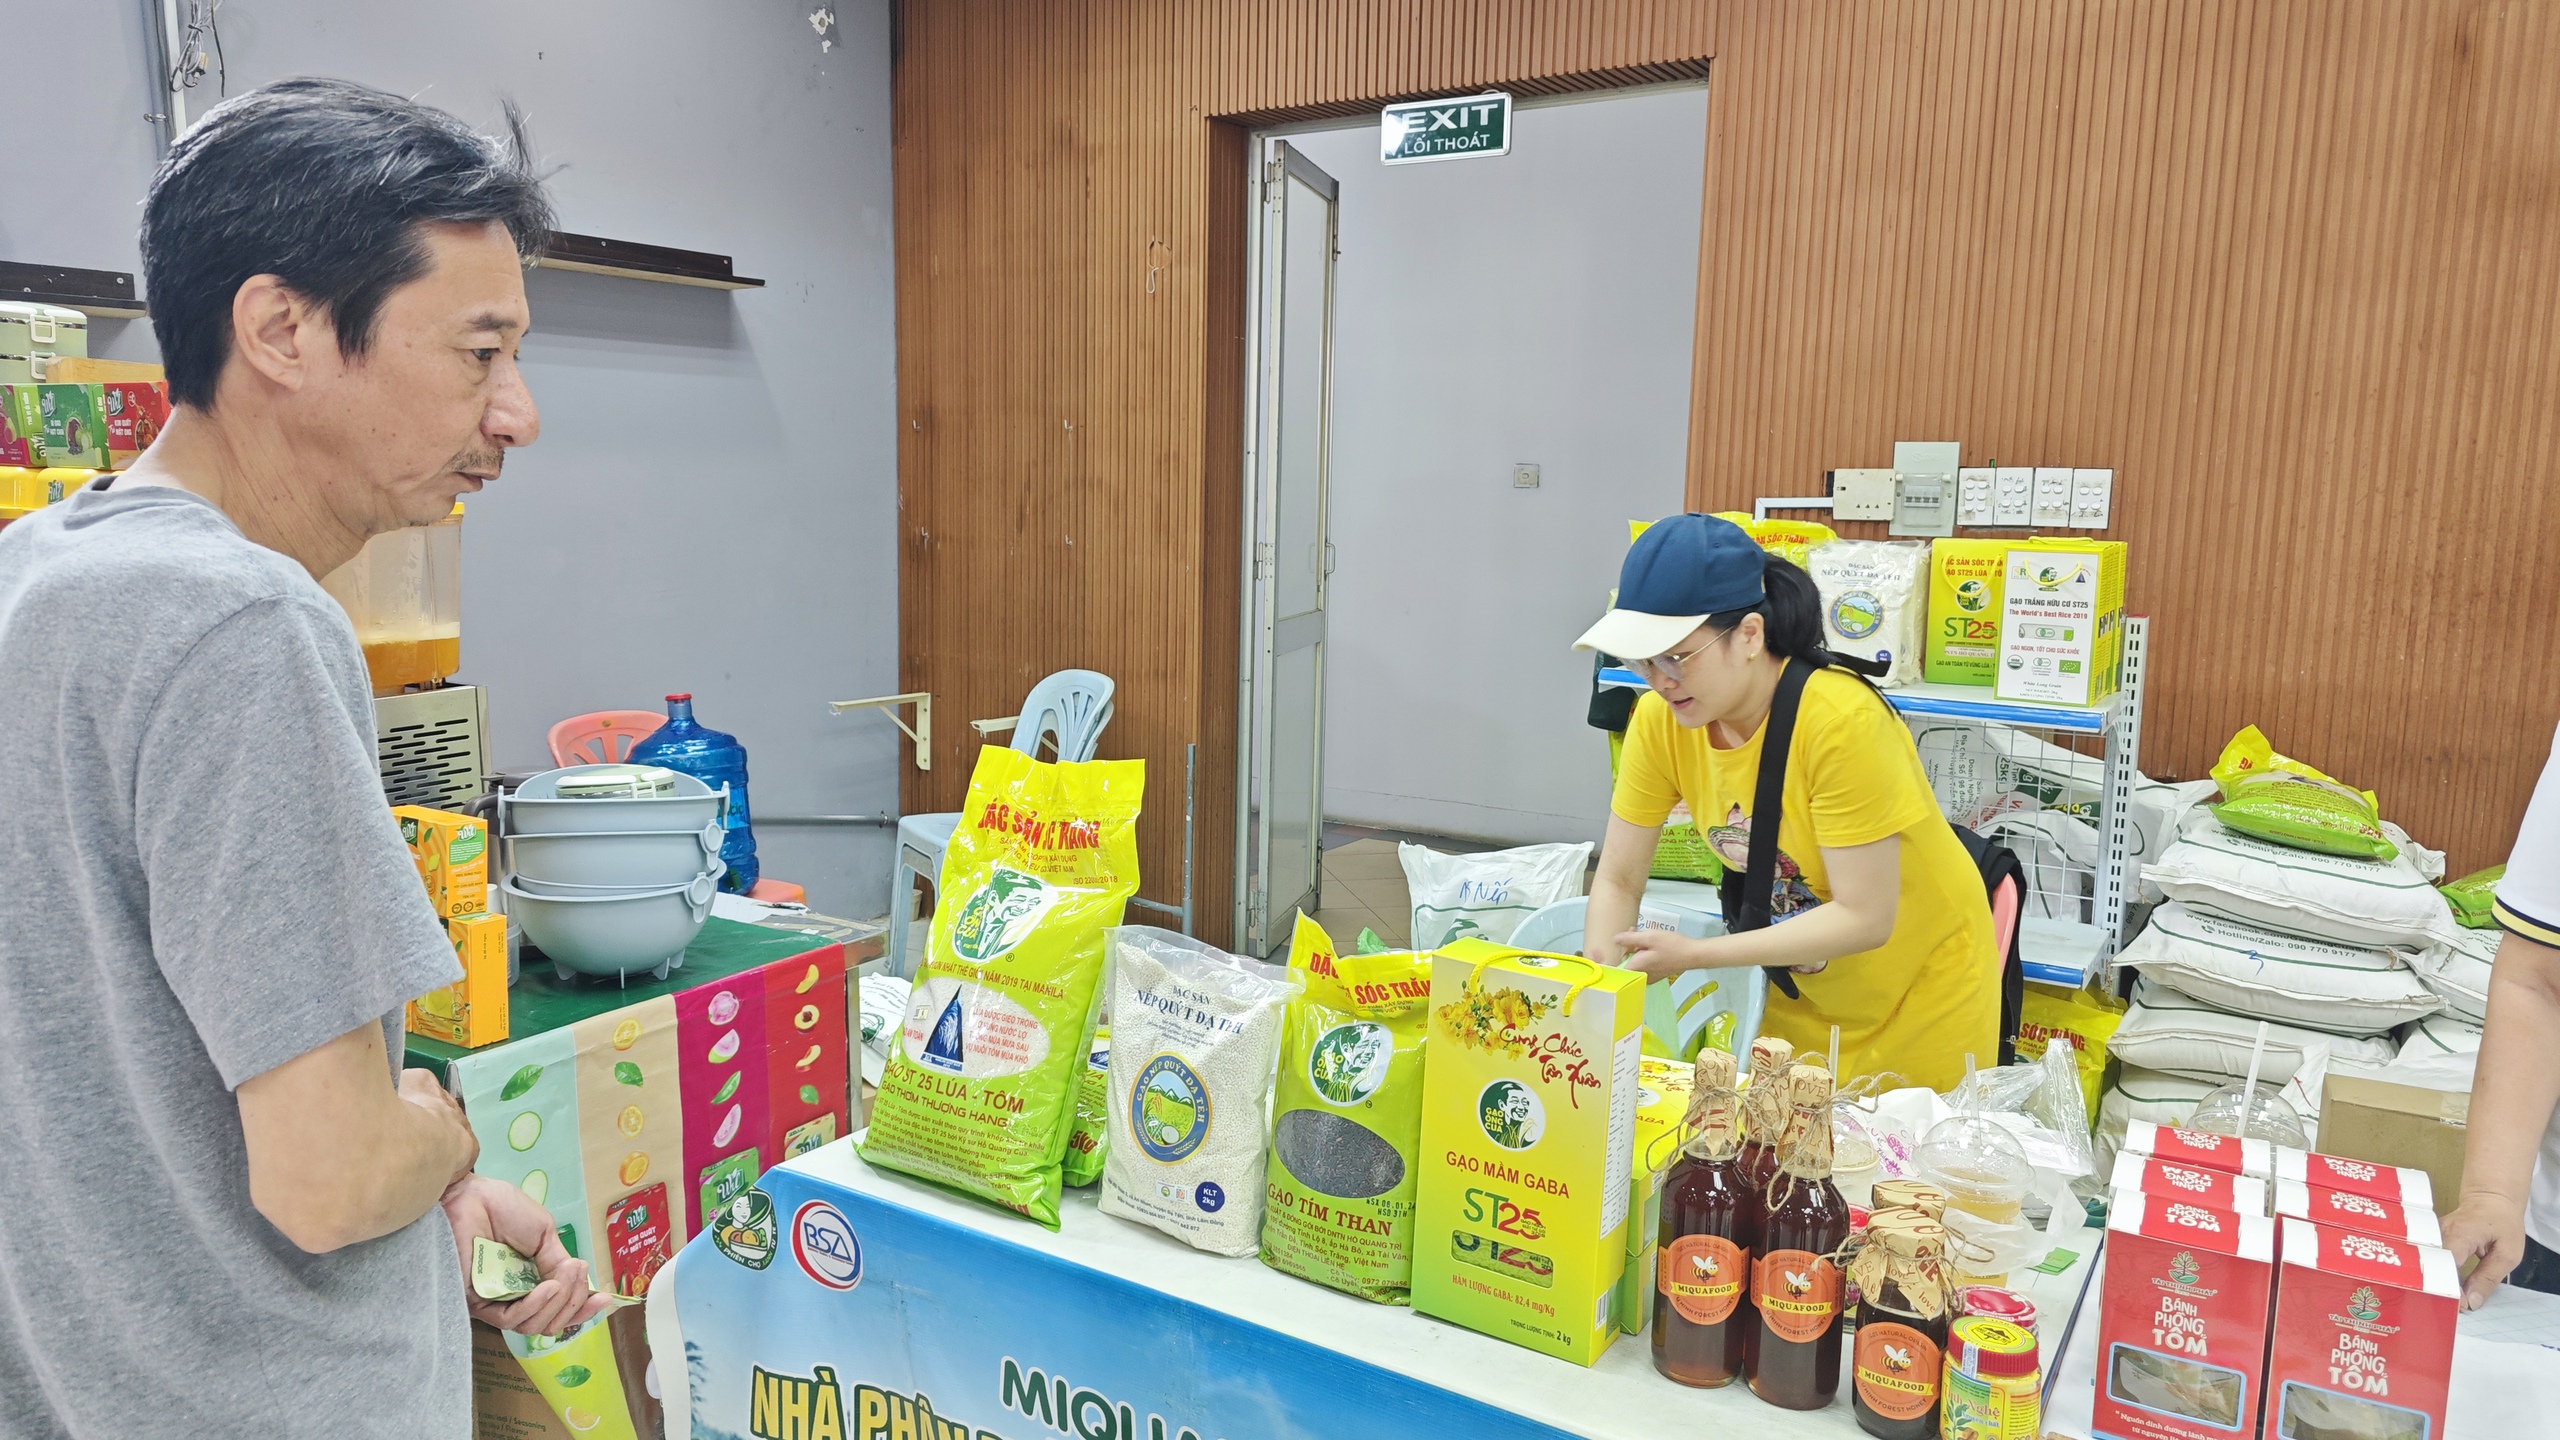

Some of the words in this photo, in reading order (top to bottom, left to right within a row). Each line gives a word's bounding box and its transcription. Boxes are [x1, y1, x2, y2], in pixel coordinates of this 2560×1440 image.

[1401, 103, 1498, 133] EXIT
[1404, 133, 1430, 155] LỐI
[1434, 130, 1490, 152] THOÁT
[2009, 598, 2022, 607] GẠO
[2021, 609, 2042, 617] World's
[1944, 616, 1997, 640] ST25
[2334, 860, 2352, 868] 770
[2355, 865, 2381, 873] 9177
[2218, 929, 2285, 948] Hotline/Zalo:
[2287, 942, 2306, 950] 090
[2310, 945, 2329, 954] 770
[2331, 948, 2357, 958] 9177
[984, 970, 1001, 984] NĂM
[1002, 975, 1018, 988] 2019
[1020, 979, 1031, 992] TẠI
[1032, 981, 1064, 1000] MANILA
[1354, 981, 1390, 1005] SÓC
[1388, 977, 1431, 999] TRĂN
[1158, 997, 1194, 1021] QUÝT
[1499, 1022, 1542, 1059] Cung
[1543, 1032, 1584, 1058] Chúc
[2020, 1022, 2048, 1043] SÓC
[884, 1059, 905, 1079] GẠO
[902, 1067, 917, 1085] ST
[917, 1072, 933, 1091] 25
[935, 1077, 968, 1101] LÚA
[983, 1090, 1025, 1114] TÔM
[1538, 1054, 1563, 1084] Tân
[1565, 1058, 1602, 1110] Xuân
[881, 1080, 895, 1094] GẠO
[896, 1085, 919, 1105] THƠM
[921, 1096, 968, 1118] THƯỢNG
[968, 1112, 1009, 1128] HẠNG
[1484, 1122, 1503, 1134] CUA
[1636, 1114, 1665, 1125] ABA
[1446, 1150, 1479, 1172] GẠO
[1483, 1160, 1519, 1185] MẦM
[1523, 1173, 1570, 1199] GABA
[1201, 1196, 1216, 1207] 2kg
[1203, 1187, 1218, 1197] KLT
[1267, 1182, 1294, 1208] GẠO
[1298, 1197, 1330, 1222] TÍM
[1335, 1209, 1393, 1237] THAN
[1462, 1187, 1544, 1241] ST25
[643, 1235, 657, 1247] ONG
[803, 1221, 854, 1263] BSA
[1302, 1219, 1314, 1231] GÓI
[1326, 1229, 1346, 1241] DNTN
[1359, 1237, 1388, 1250] QUANG
[1352, 1255, 1369, 1267] Việt
[1370, 1259, 1389, 1269] Nam
[1887, 1263, 1909, 1280] love
[1361, 1277, 1380, 1286] 0972
[1677, 1284, 1732, 1295] MIQUAFOOD
[1452, 1272, 1467, 1287] HÀM
[1469, 1279, 1492, 1295] LƯỢNG
[1493, 1287, 1514, 1303] GABA:
[1514, 1294, 1530, 1308] 82,4
[1531, 1301, 1555, 1318] mg/Kg
[1768, 1297, 1825, 1313] MIQUAFOOD
[1918, 1290, 1937, 1313] love
[2161, 1295, 2198, 1317] BÁNH
[1694, 1310, 1719, 1319] FOREST
[1719, 1296, 1736, 1314] HONEY
[1783, 1326, 1809, 1336] FOREST
[1809, 1316, 1828, 1333] HONEY
[1879, 1329, 1908, 1340] NATURAL
[1556, 1330, 1562, 1341] 2
[1562, 1333, 1572, 1346] kg
[2151, 1326, 2208, 1357] TÔM
[2338, 1332, 2379, 1355] BÁNH
[1864, 1370, 1926, 1392] MIQUAFOOD
[2327, 1364, 2389, 1397] TÔM
[750, 1364, 848, 1440] NHÀ
[1877, 1400, 1906, 1413] FOREST
[1906, 1397, 1927, 1412] HONEY
[1967, 1398, 2001, 1420] Nghệ
[2145, 1421, 2163, 1431] dinh
